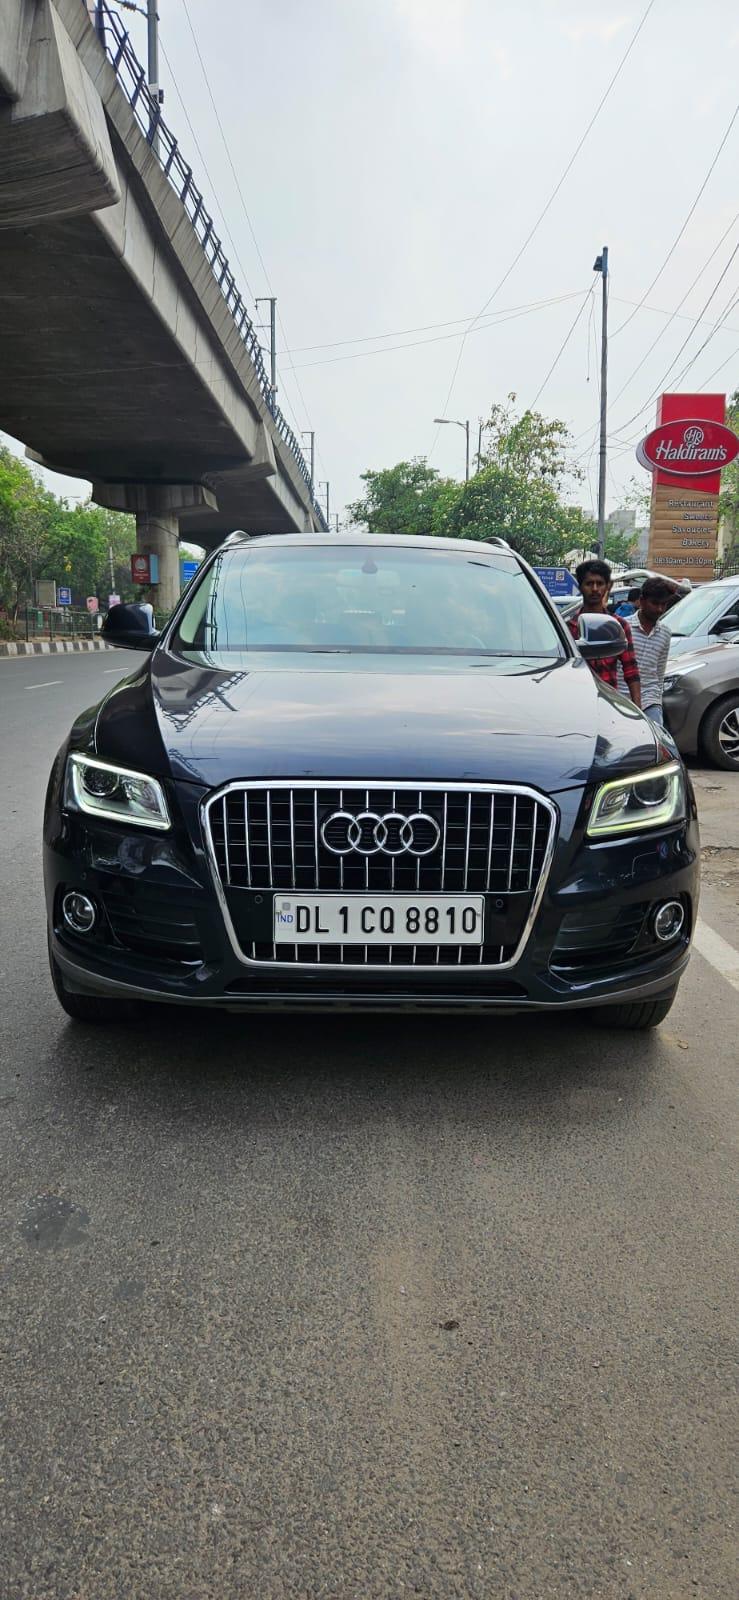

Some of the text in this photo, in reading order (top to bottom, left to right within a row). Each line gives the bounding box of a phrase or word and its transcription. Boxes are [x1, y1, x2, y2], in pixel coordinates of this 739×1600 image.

[655, 440, 728, 460] Haldiram's
[668, 499, 713, 508] Restaurant
[682, 538, 710, 549] Bakery
[276, 914, 294, 924] IND
[295, 905, 477, 935] DL 1 CQ 8810
